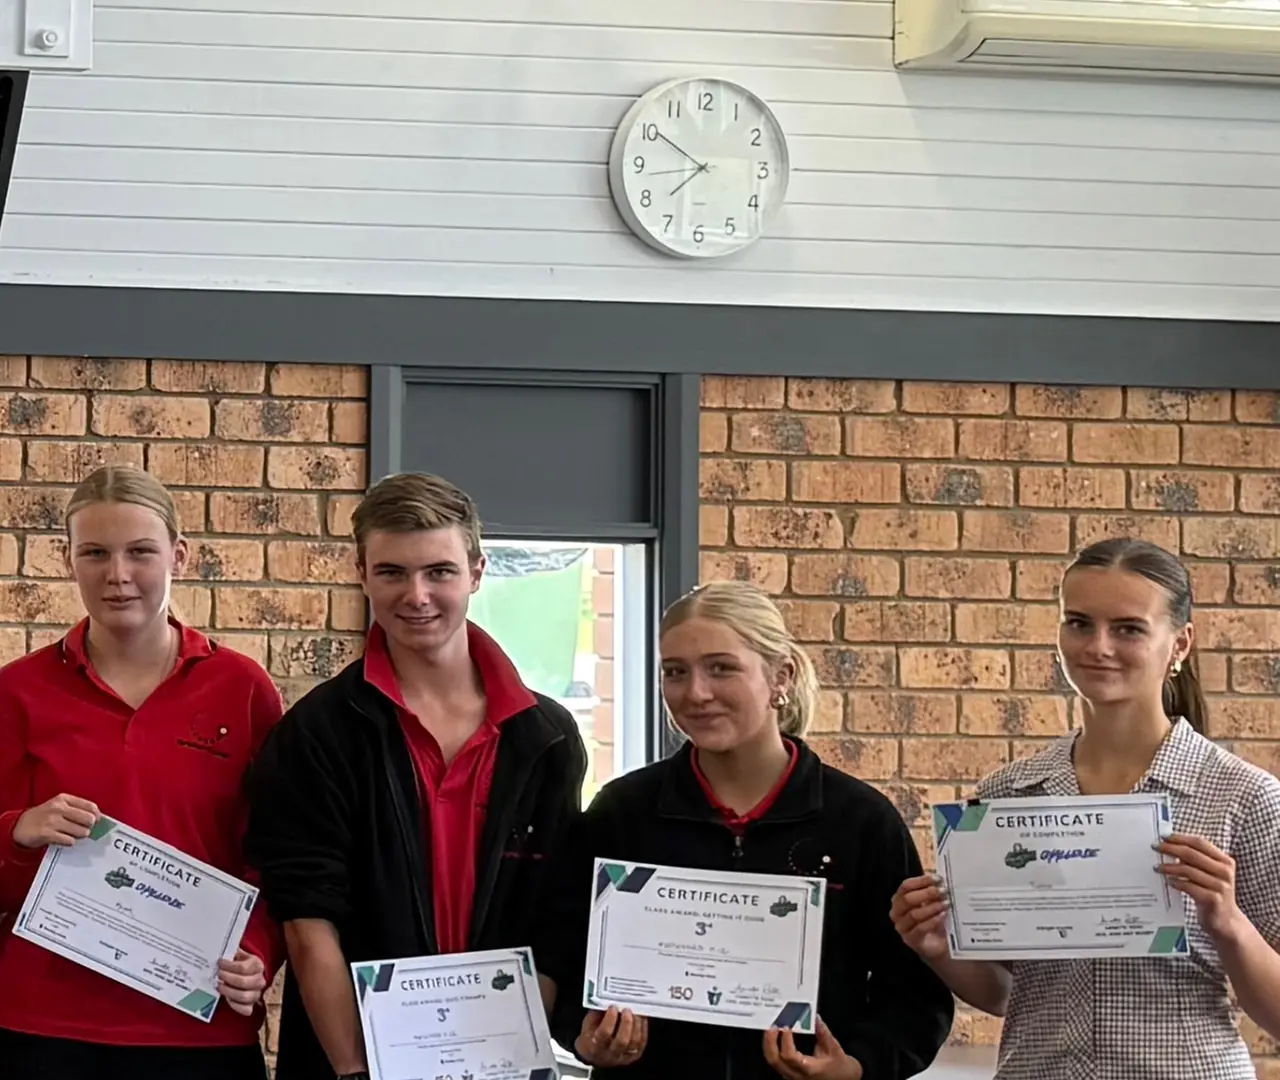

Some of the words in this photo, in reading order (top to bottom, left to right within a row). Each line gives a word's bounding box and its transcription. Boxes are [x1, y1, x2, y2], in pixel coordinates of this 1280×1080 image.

[668, 100, 681, 118] 11
[698, 93, 714, 111] 12
[642, 123, 658, 142] 10
[750, 128, 762, 146] 2
[633, 156, 645, 174] 9
[757, 161, 769, 180] 3
[640, 189, 652, 207] 8
[747, 194, 759, 212] 4
[662, 214, 674, 232] 7
[724, 218, 736, 236] 5
[692, 225, 705, 243] 6
[995, 813, 1104, 828] CERTIFICATE
[113, 838, 202, 887] CERTIFICATE
[657, 887, 760, 906] CERTIFICATE
[401, 973, 481, 991] CERTIFICATE
